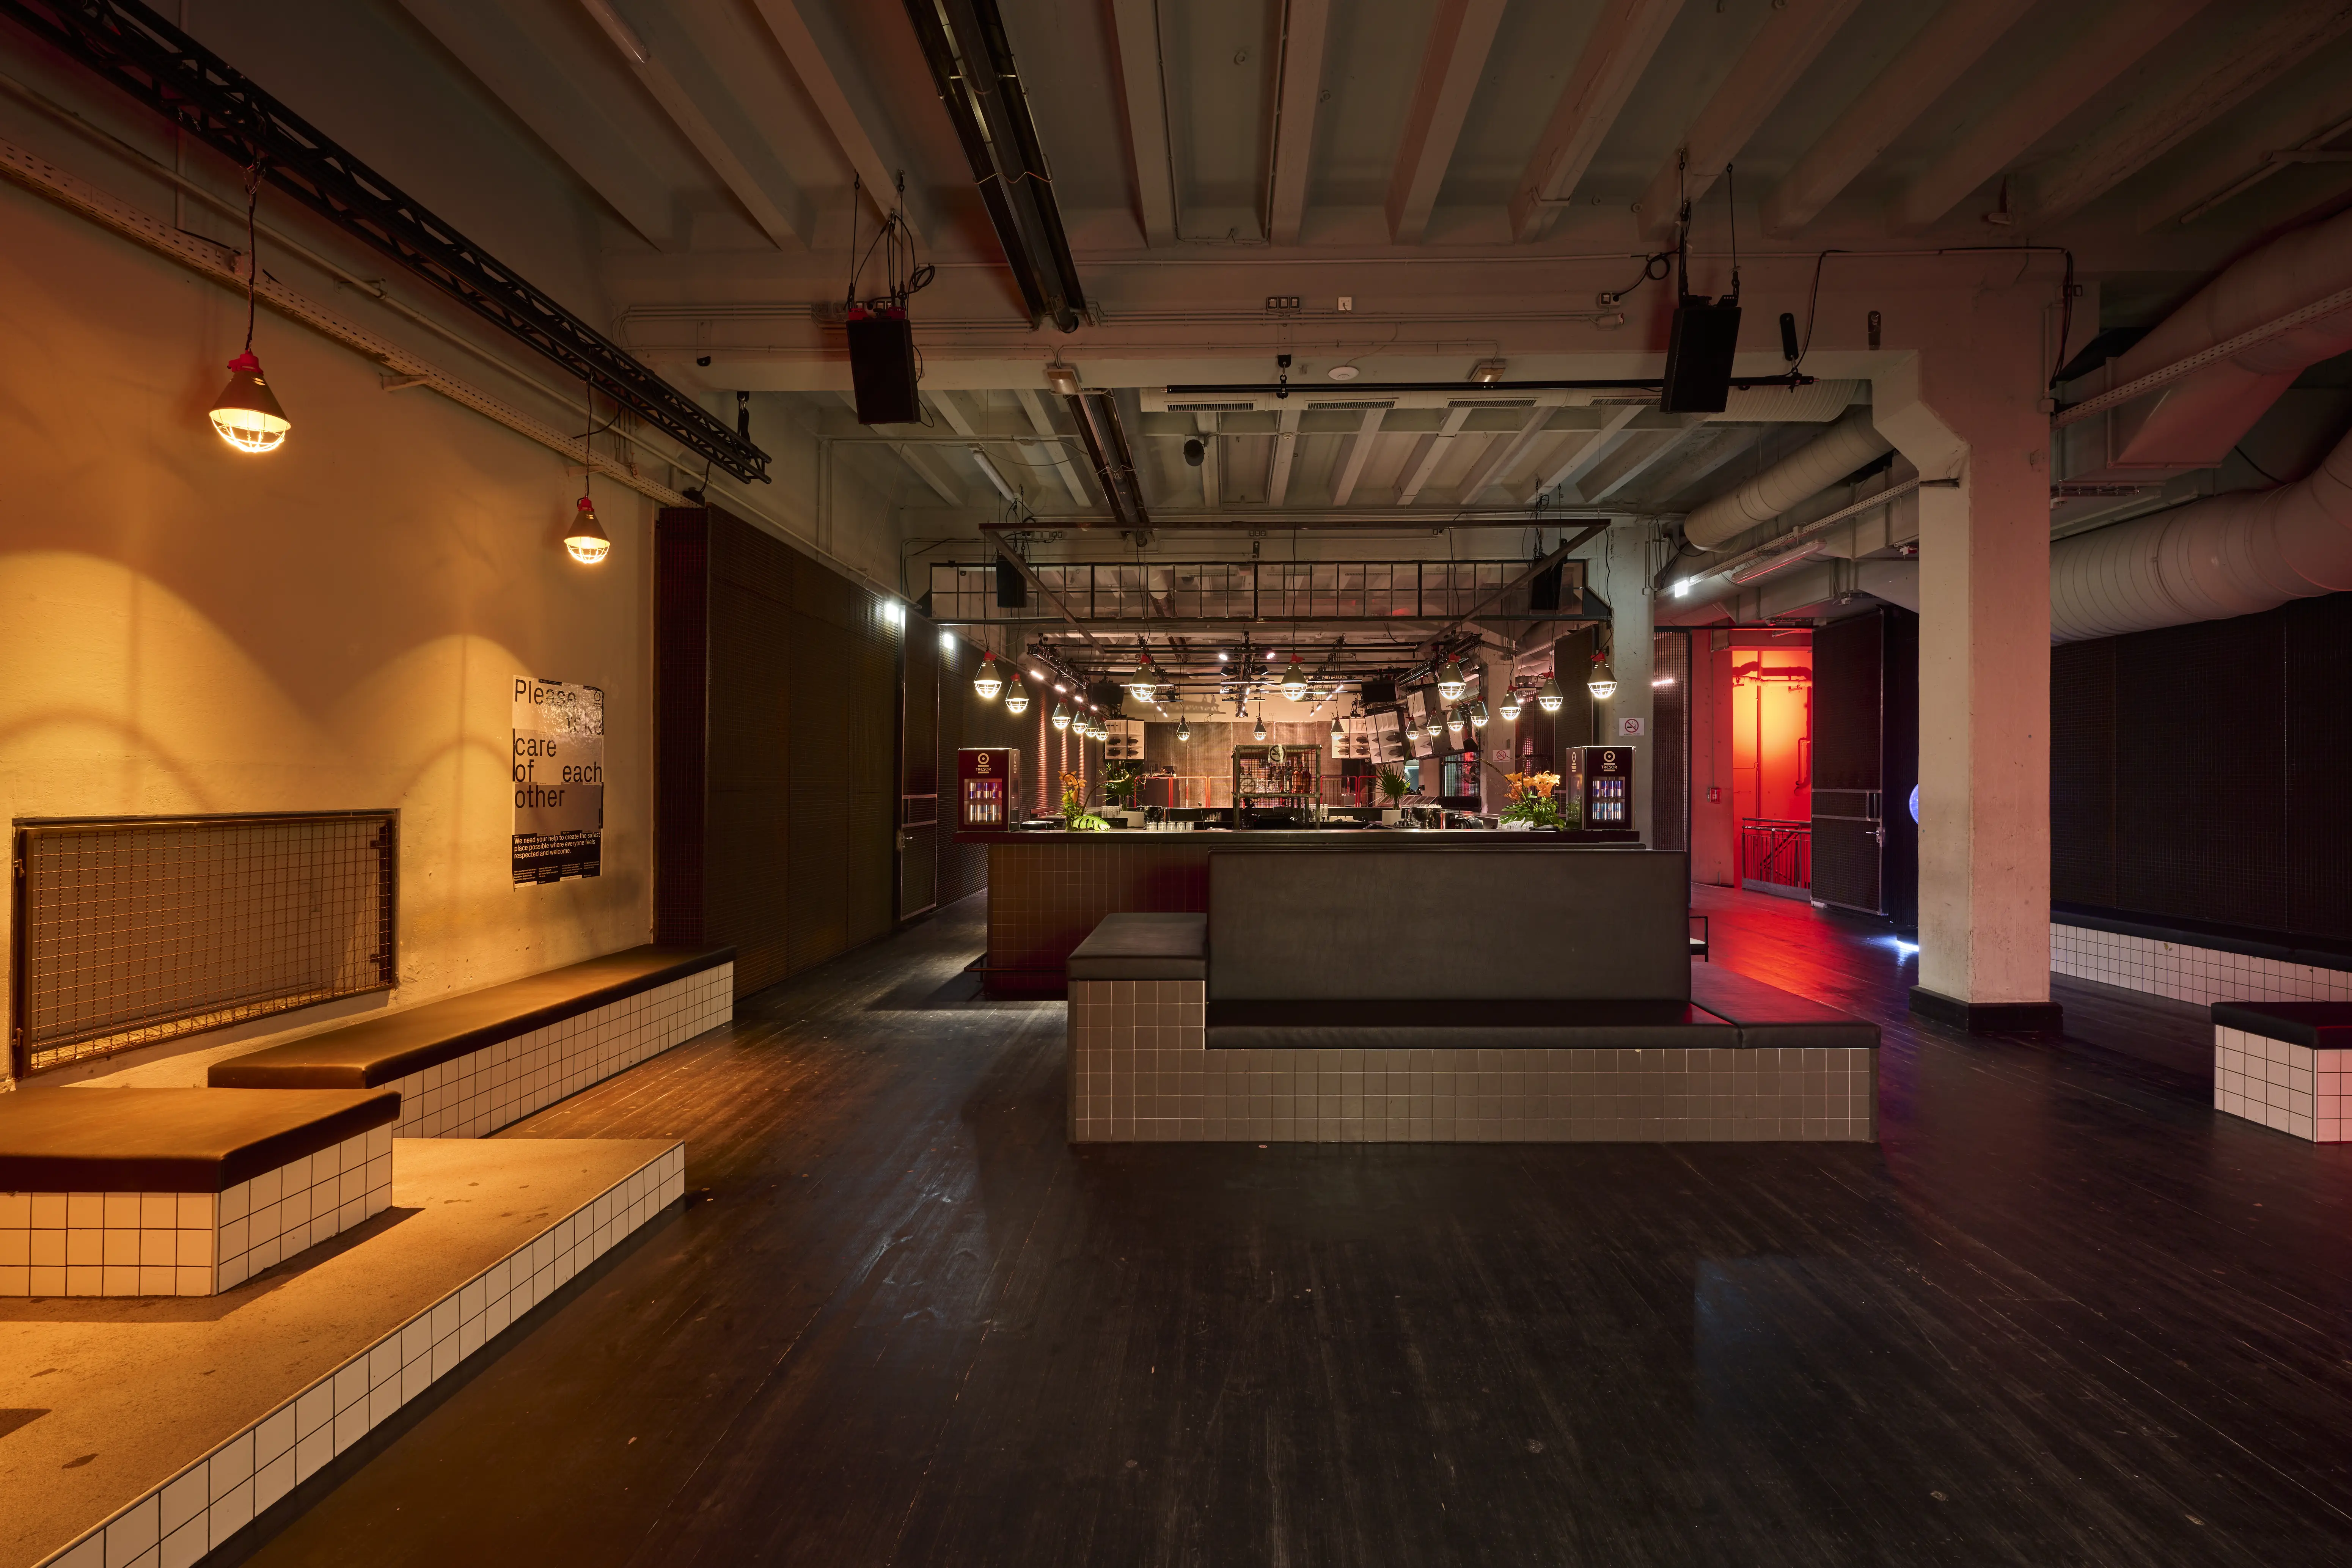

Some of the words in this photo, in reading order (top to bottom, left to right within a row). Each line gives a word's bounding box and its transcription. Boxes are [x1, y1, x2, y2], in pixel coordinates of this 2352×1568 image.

[515, 679, 576, 708] Please
[566, 713, 602, 735] take
[515, 738, 556, 757] care
[515, 759, 534, 782] of
[563, 761, 602, 782] each
[515, 785, 565, 808] other
[514, 851, 539, 859] respected
[529, 843, 549, 851] possible
